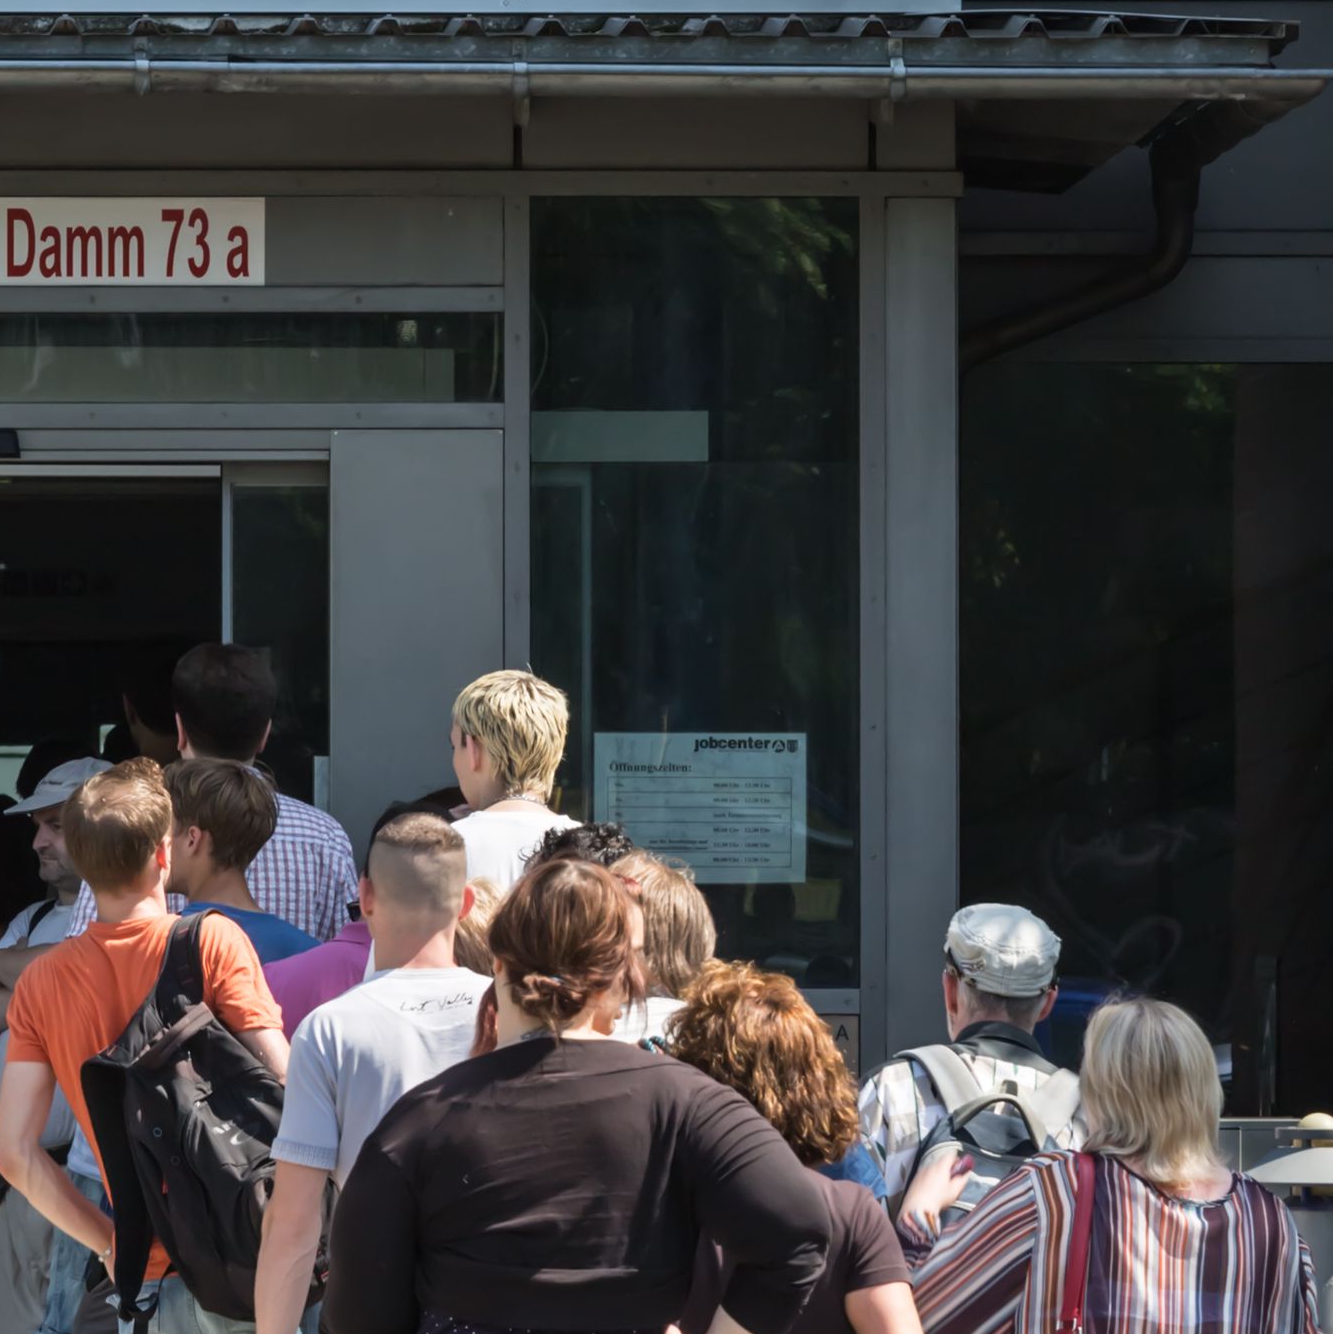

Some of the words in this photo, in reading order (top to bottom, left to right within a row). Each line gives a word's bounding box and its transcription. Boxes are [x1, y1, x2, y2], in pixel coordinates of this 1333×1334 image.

[6, 206, 146, 279] Damm
[161, 206, 212, 279] 73
[226, 224, 250, 279] a
[693, 736, 771, 753] jobcenter
[608, 761, 693, 774] Öffnungszeiten:
